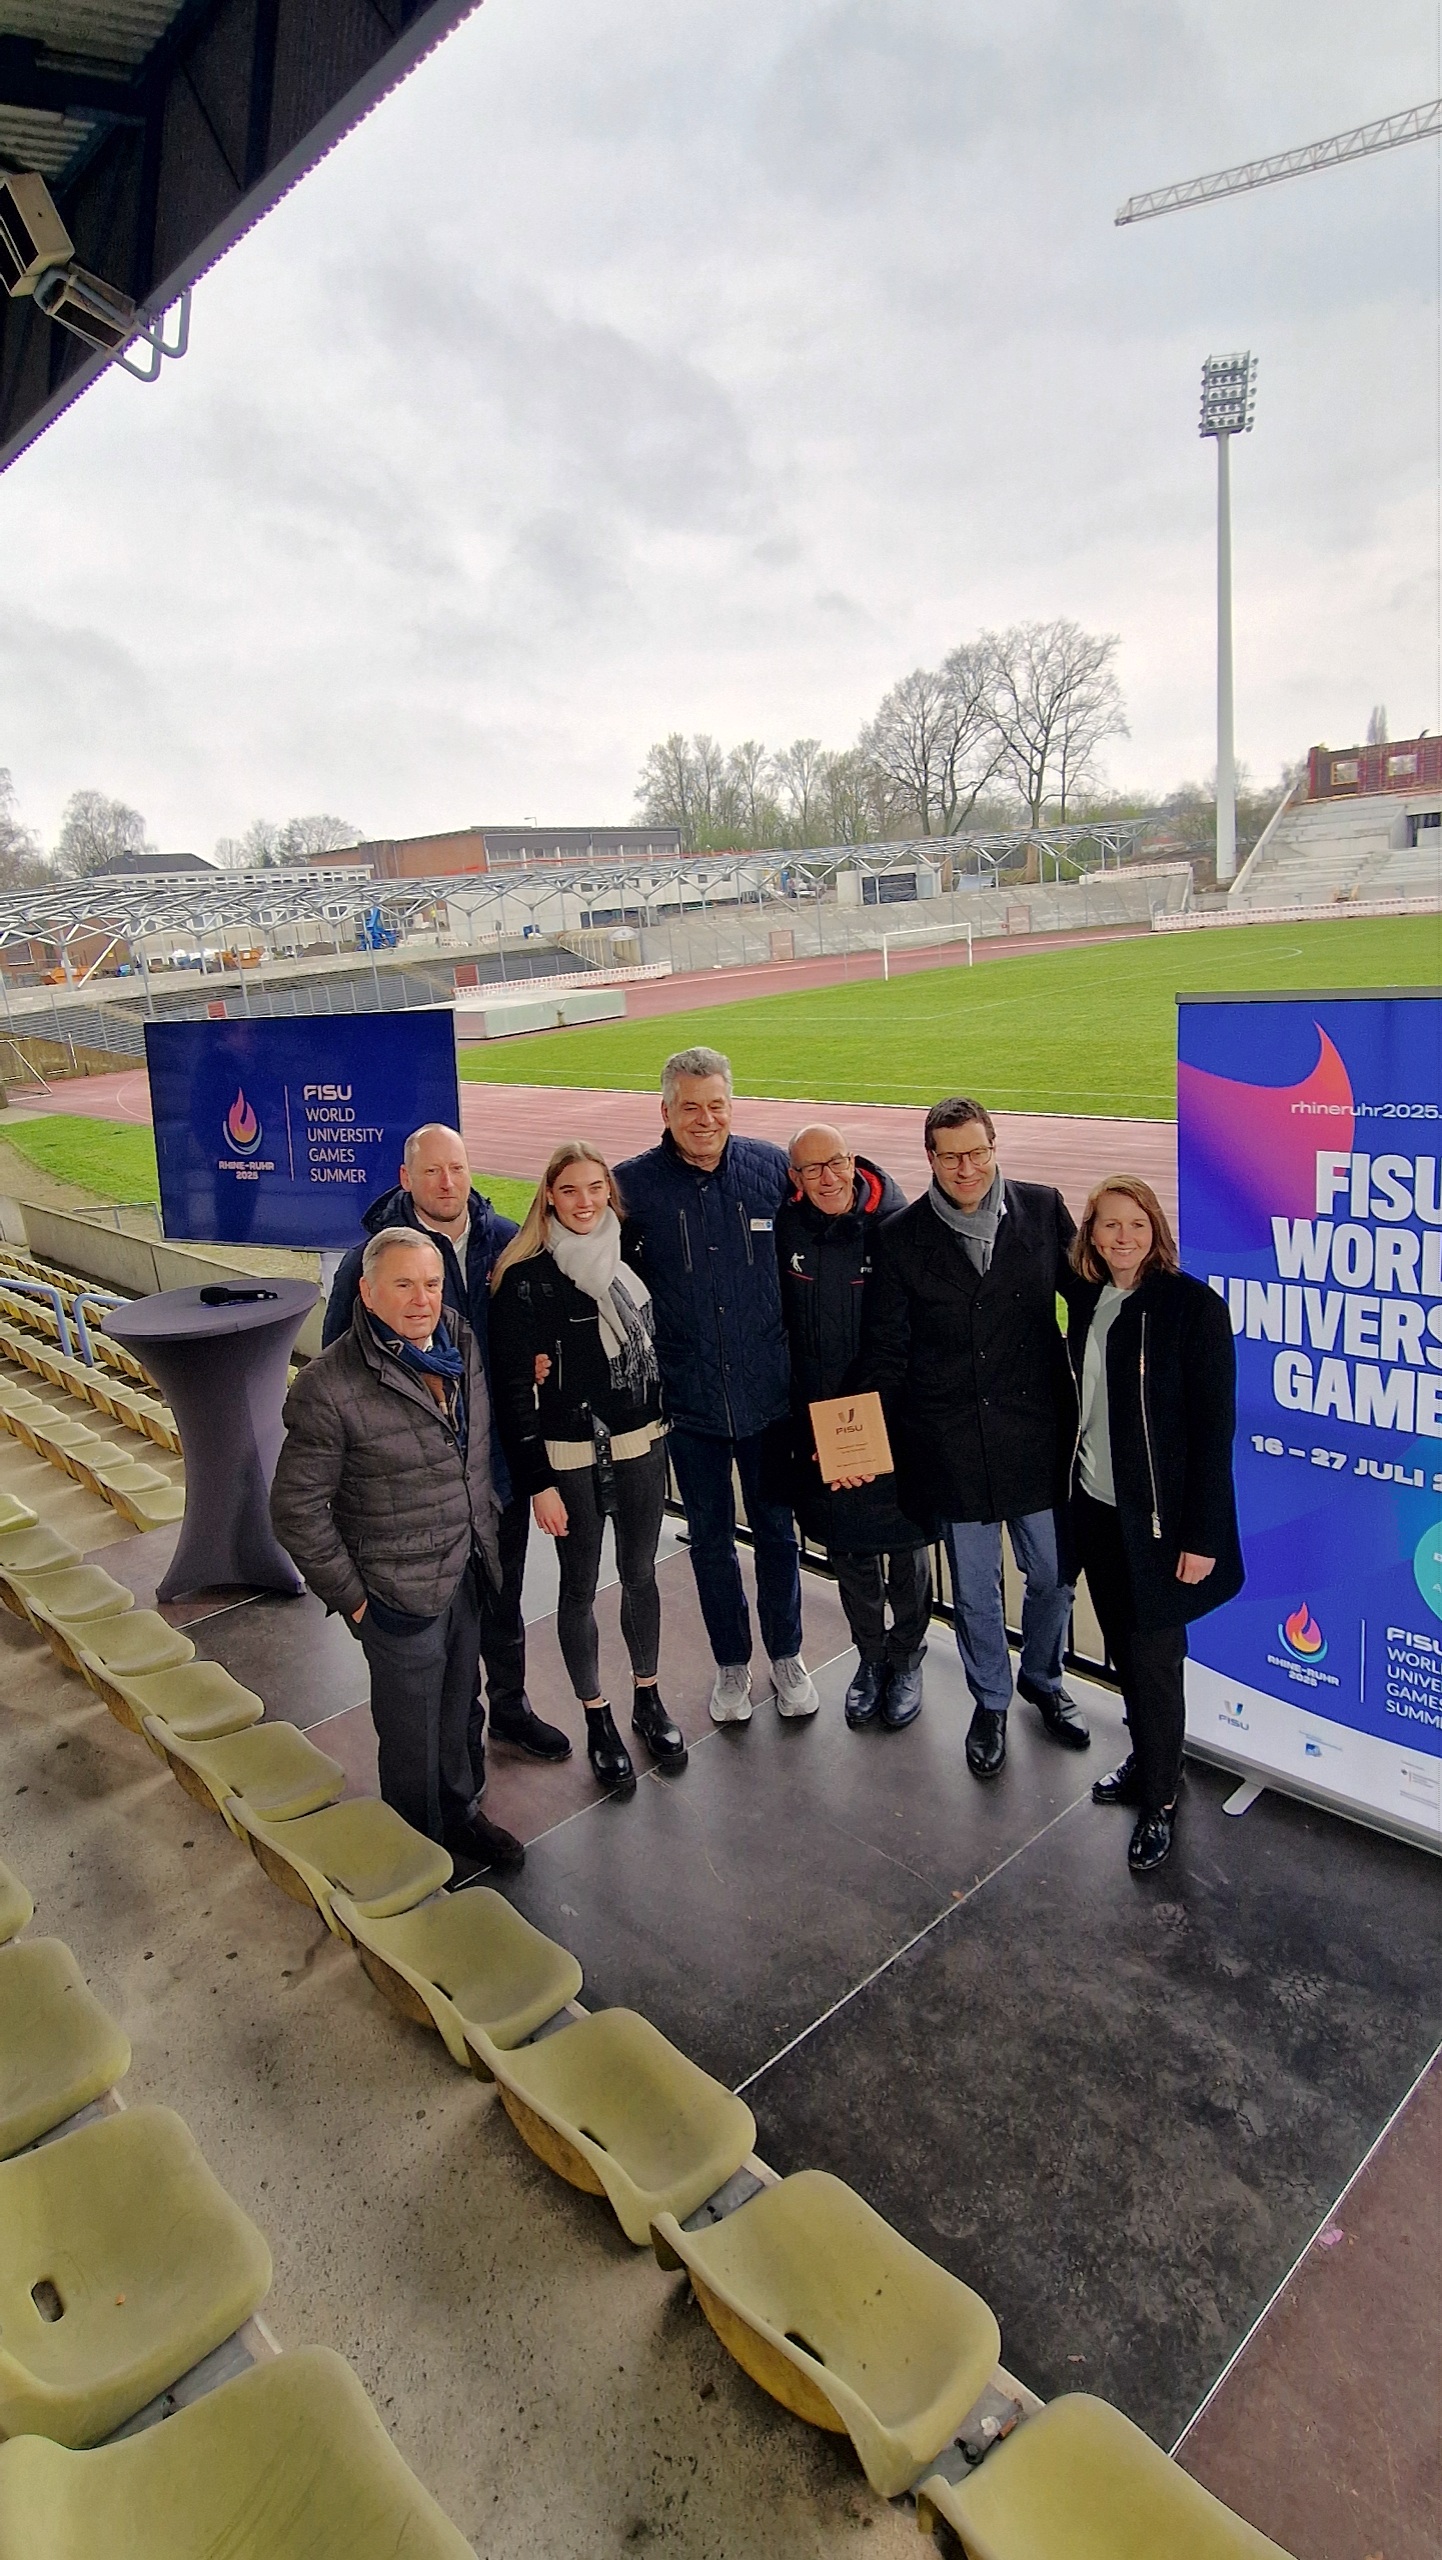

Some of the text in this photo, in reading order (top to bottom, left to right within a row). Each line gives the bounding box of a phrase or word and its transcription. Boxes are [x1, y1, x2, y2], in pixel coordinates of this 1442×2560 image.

[303, 1084, 352, 1101] FISU
[306, 1108, 355, 1122] WORLD
[308, 1128, 384, 1143] UNIVERSITY
[309, 1148, 355, 1163] GAMES
[310, 1169, 366, 1184] SUMMER
[1316, 1150, 1442, 1225] FISU
[835, 1424, 863, 1435] FISU
[1251, 1435, 1284, 1456] 16
[1310, 1448, 1347, 1470] 27
[1354, 1458, 1424, 1488] JULI
[1387, 1645, 1442, 1675] WORL
[1387, 1664, 1442, 1694] UNIVE
[1218, 1714, 1250, 1731] FISU
[1386, 1699, 1442, 1730] SUMM
